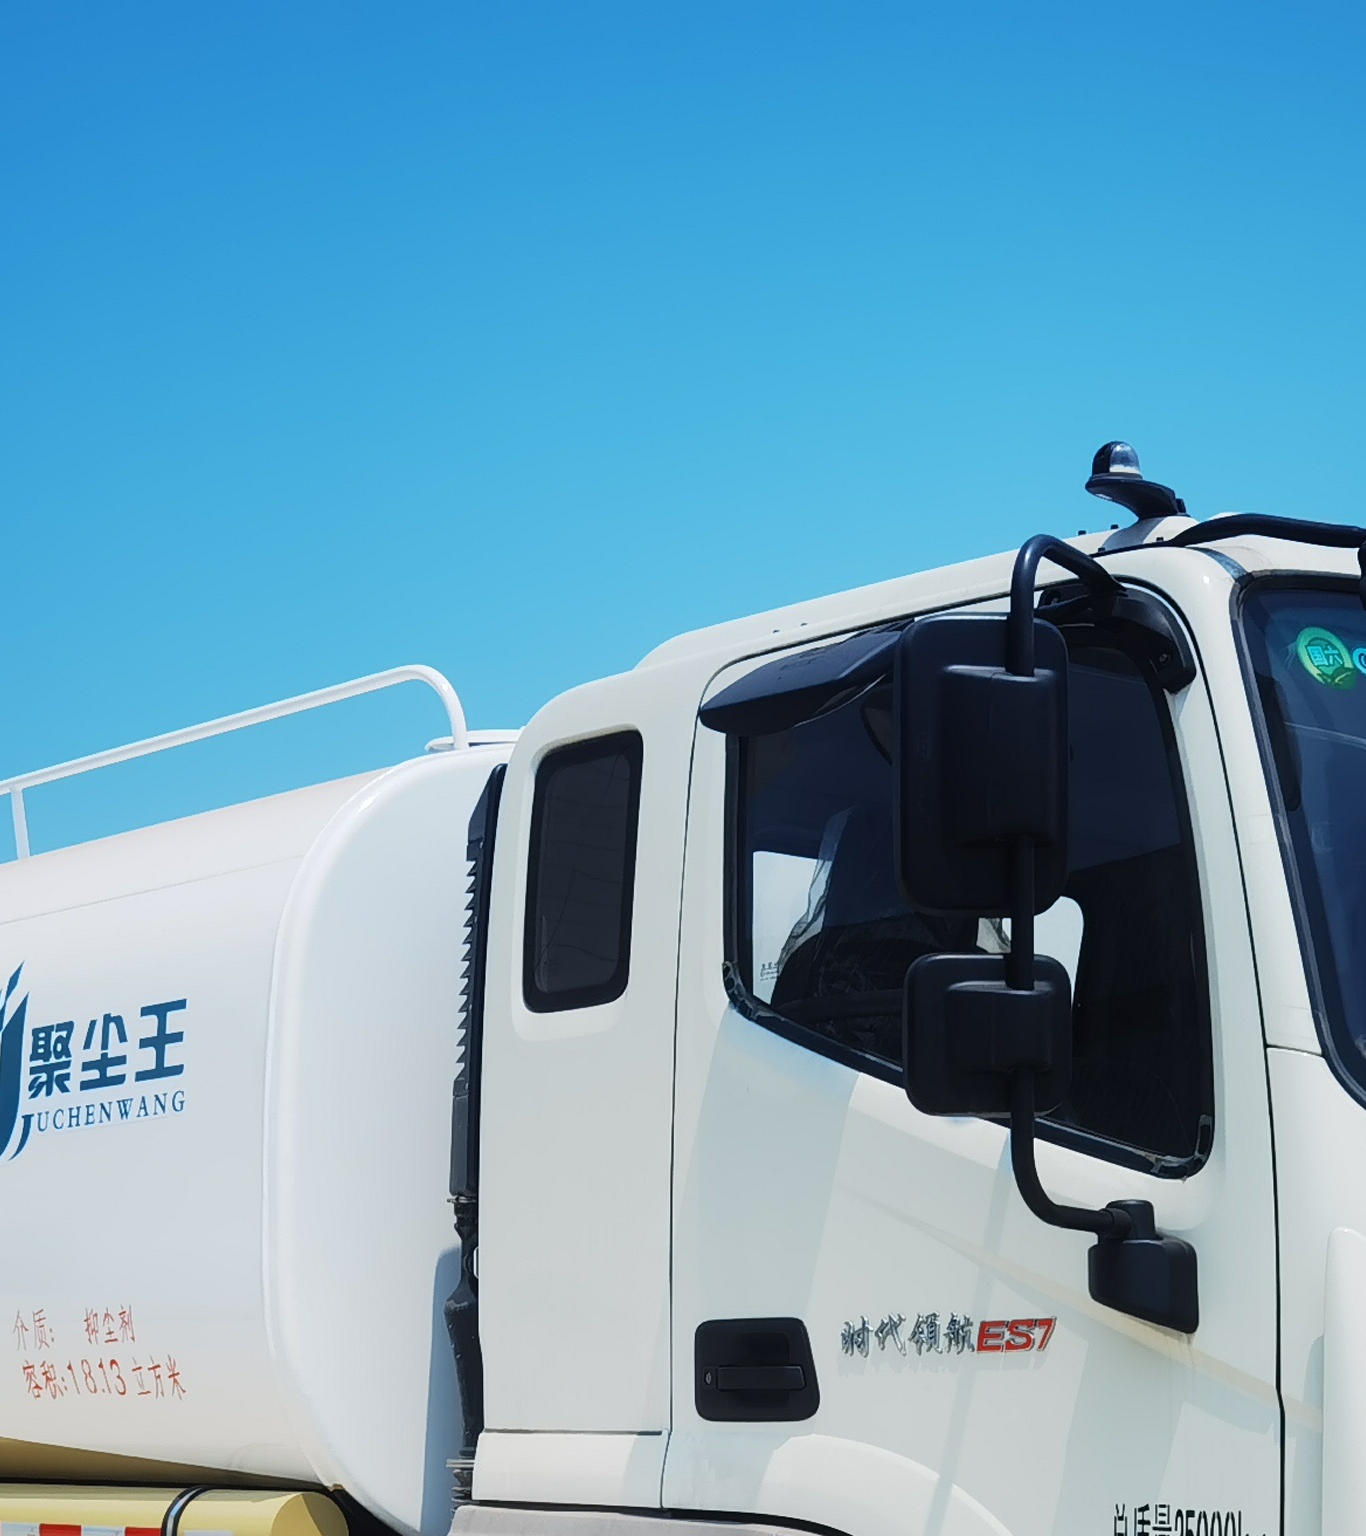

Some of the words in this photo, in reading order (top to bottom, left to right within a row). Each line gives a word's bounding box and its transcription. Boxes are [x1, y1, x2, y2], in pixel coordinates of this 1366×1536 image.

[1306, 645, 1344, 666] 国六
[27, 998, 188, 1100] 聚尘王
[7, 1090, 186, 1162] JUCHENWANG
[83, 1303, 136, 1346] 抑尘剂
[977, 1315, 1058, 1354] ES7
